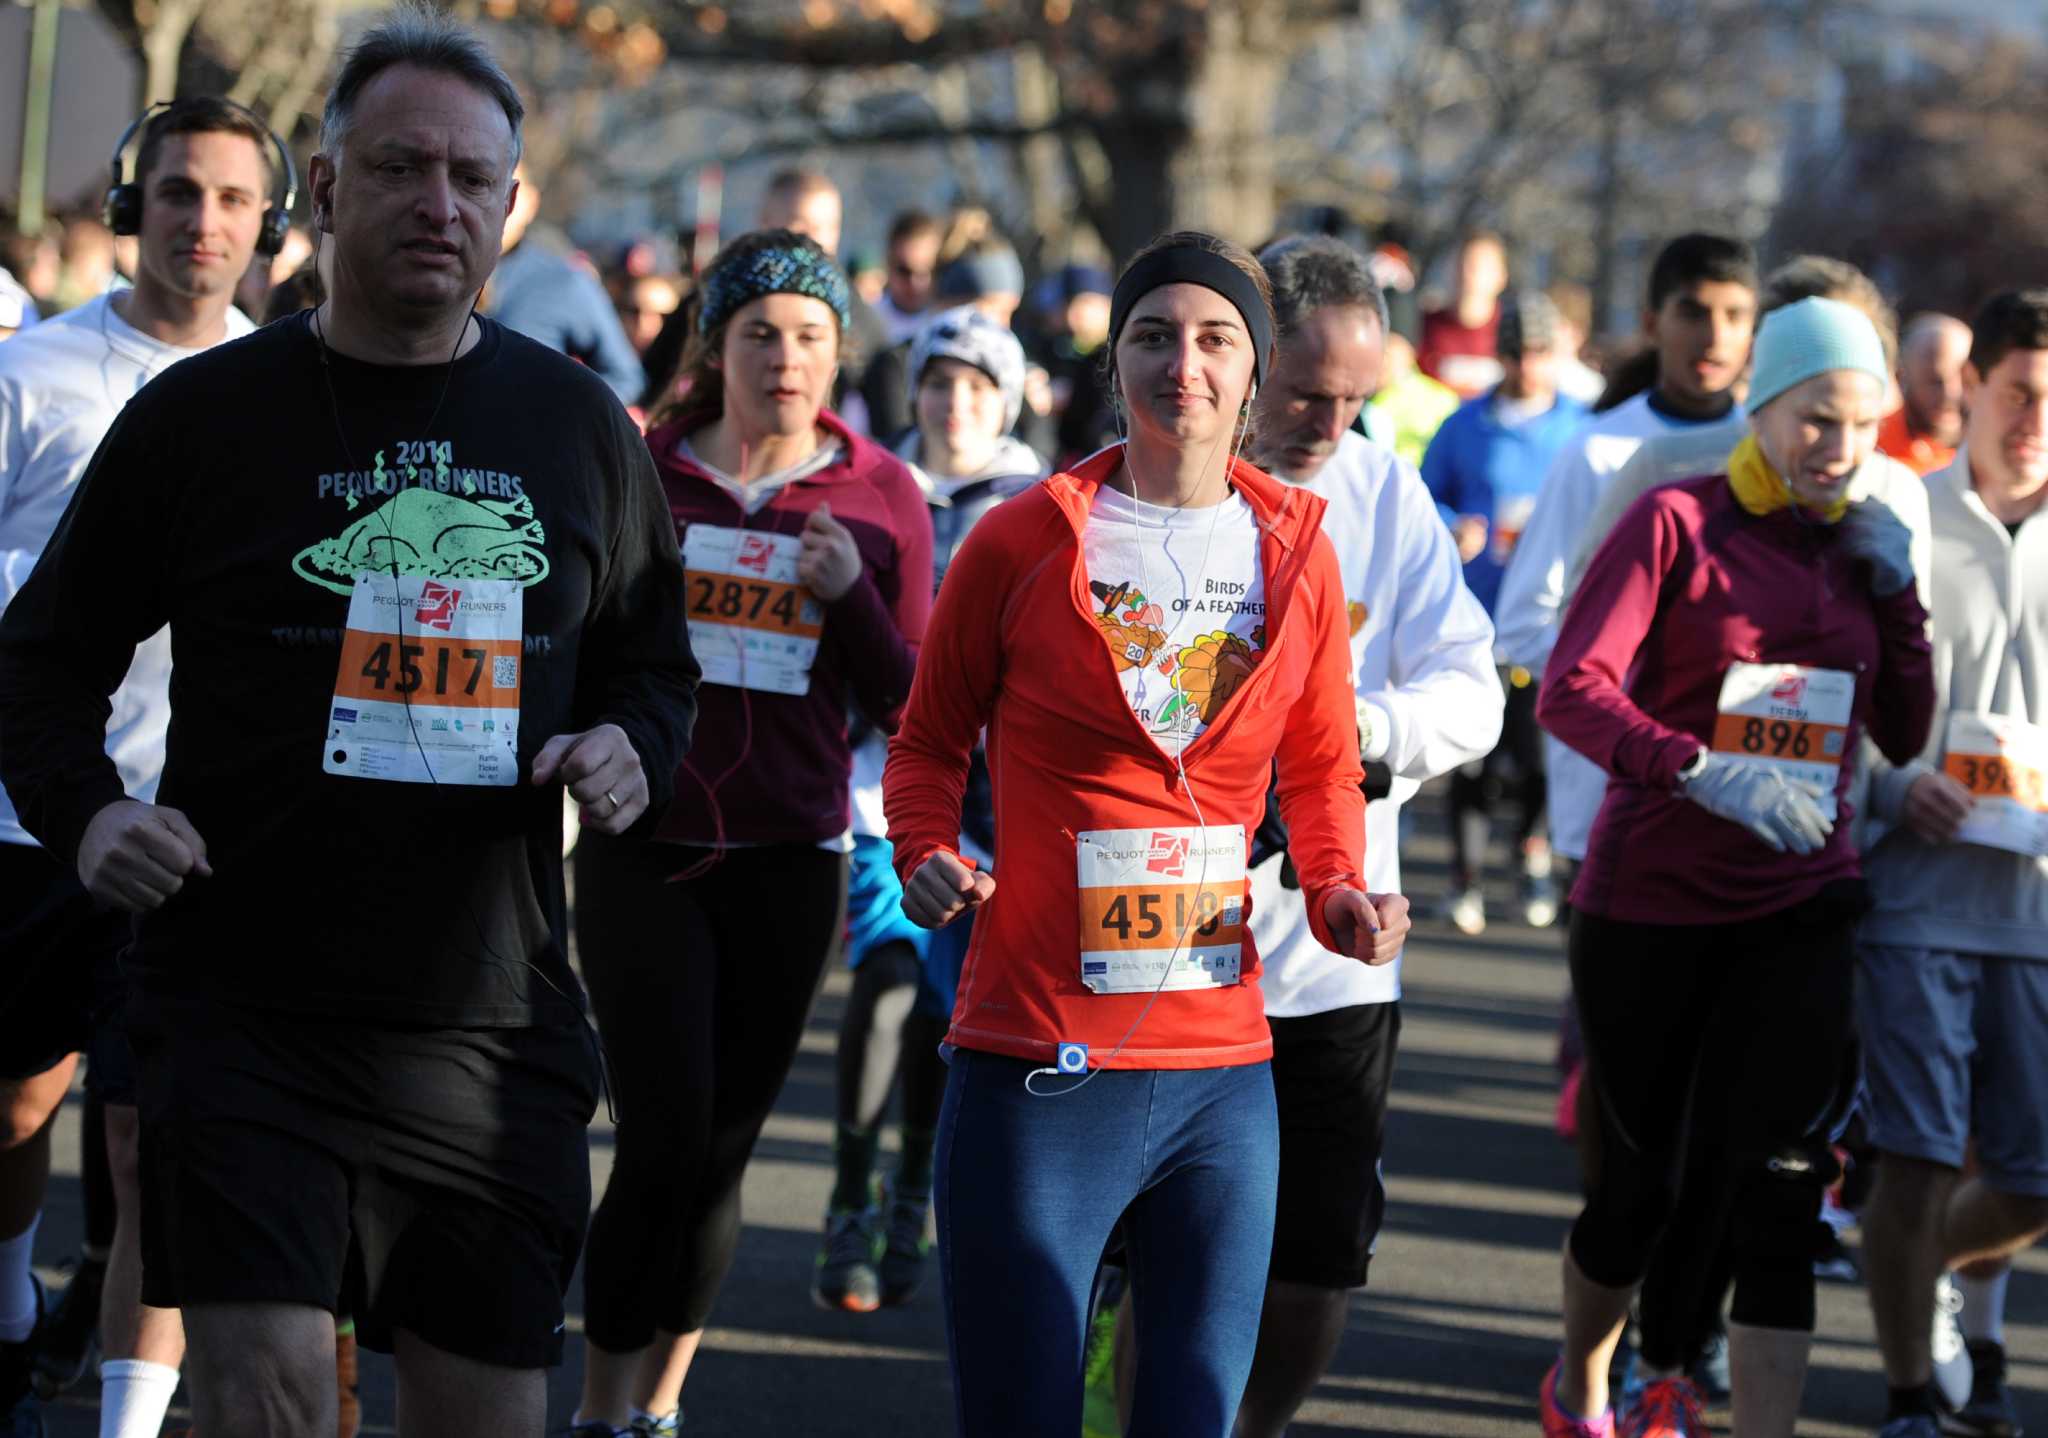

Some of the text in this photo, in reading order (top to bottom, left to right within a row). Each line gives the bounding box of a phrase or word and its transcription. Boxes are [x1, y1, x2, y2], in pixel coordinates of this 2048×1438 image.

[318, 467, 524, 501] PEQUOT RUNNERS
[372, 595, 414, 607] PEQUOT
[460, 601, 507, 612] RUNNERS
[692, 576, 797, 627] 2874
[1172, 598, 1190, 612] OF
[1194, 600, 1206, 612] A
[361, 641, 487, 696] 4517
[1127, 645, 1144, 659] 20
[1742, 717, 1810, 758] 896
[1096, 850, 1145, 861] PEQUOT
[1189, 846, 1237, 857] RUNNERS
[1101, 891, 1220, 940] 4518
